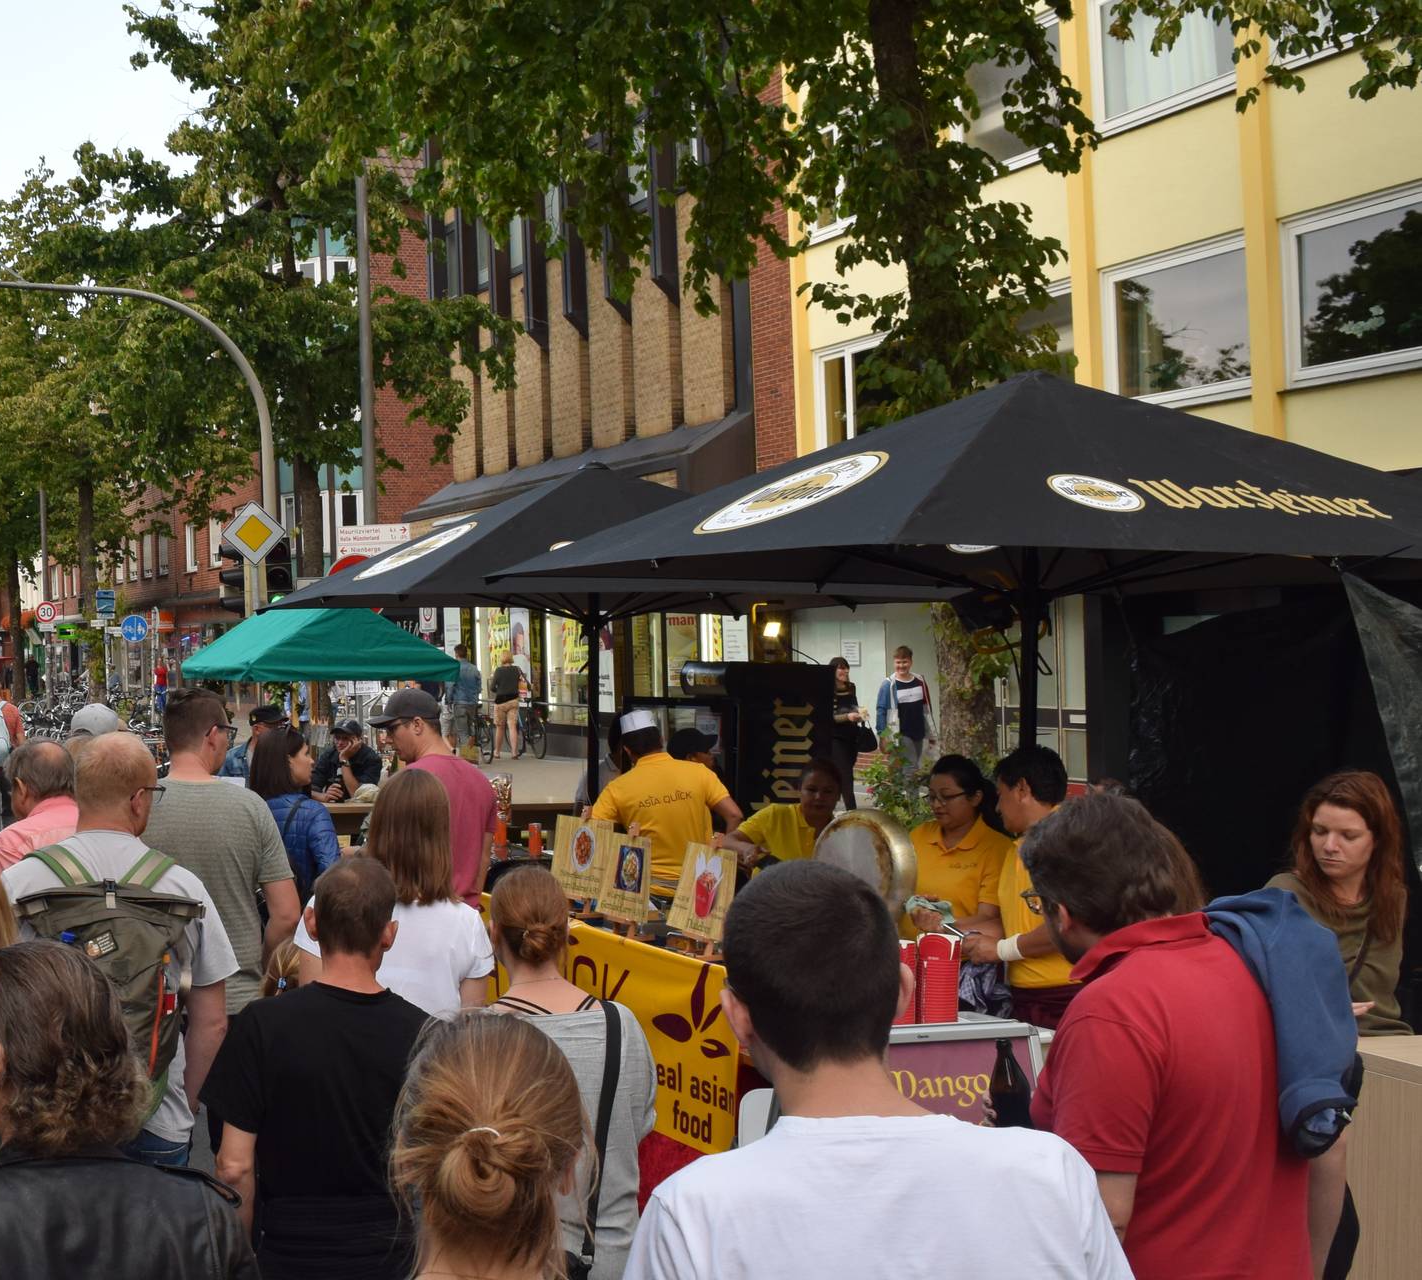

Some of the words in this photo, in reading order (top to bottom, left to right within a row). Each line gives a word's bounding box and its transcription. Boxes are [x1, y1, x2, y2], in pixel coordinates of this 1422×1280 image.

[1128, 478, 1394, 520] Warsteiner
[40, 607, 53, 618] 30
[656, 1062, 683, 1094] eal
[689, 1075, 735, 1117] asian
[672, 1100, 712, 1145] food
